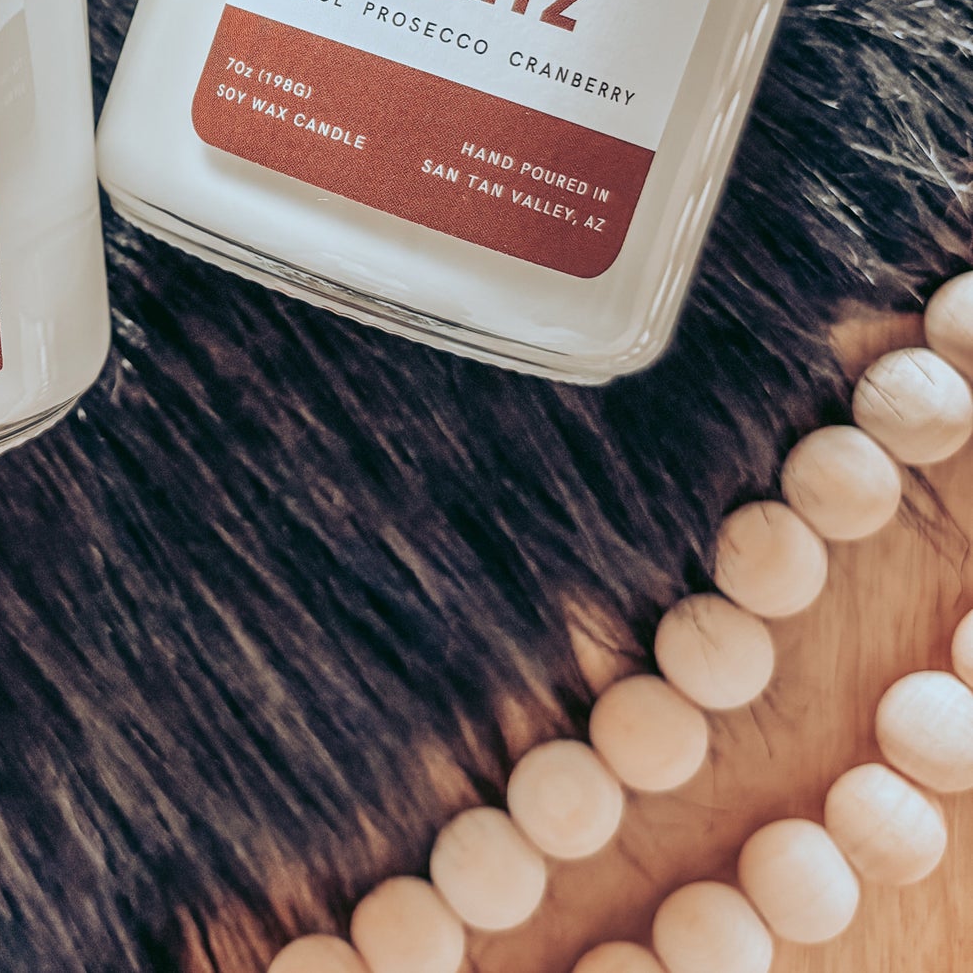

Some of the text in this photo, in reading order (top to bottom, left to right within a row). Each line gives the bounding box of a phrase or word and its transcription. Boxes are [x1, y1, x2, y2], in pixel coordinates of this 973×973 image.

[257, 68, 312, 100] (198G)
[362, 2, 490, 56] PROSECCO
[508, 50, 636, 107] CRANBERRY
[216, 83, 367, 150] SOY WAX CANDLE
[421, 158, 607, 233] SAN TAN VALLEY, AZ
[460, 141, 611, 203] HAND POURED IN
